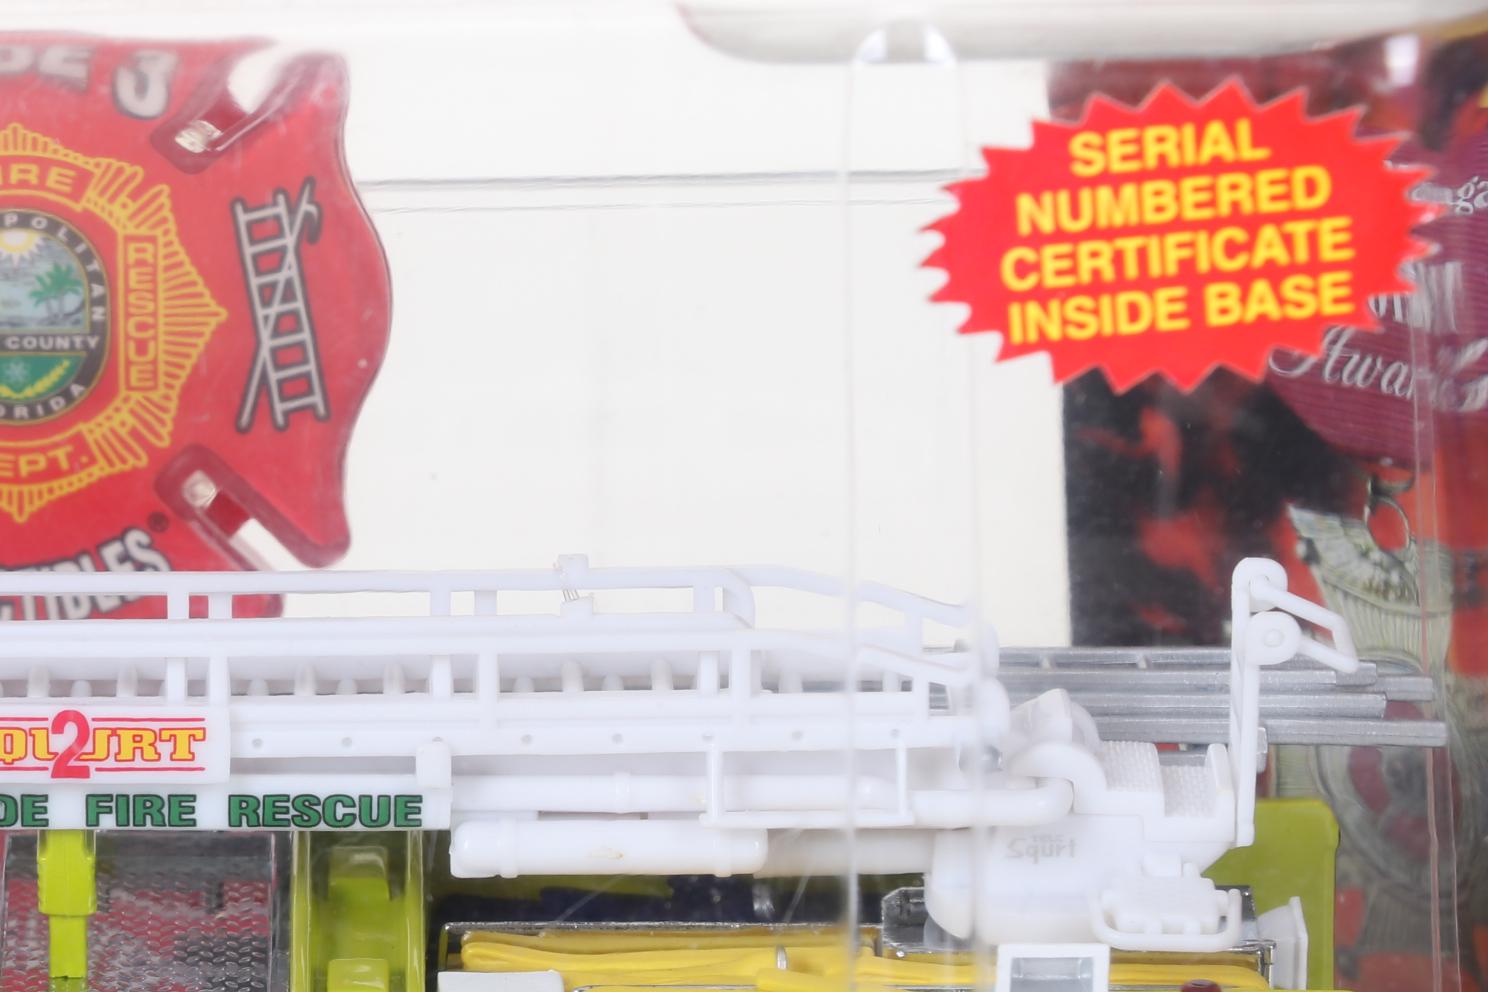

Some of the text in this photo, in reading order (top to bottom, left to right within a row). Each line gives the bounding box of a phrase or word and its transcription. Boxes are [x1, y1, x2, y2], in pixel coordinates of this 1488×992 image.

[1069, 118, 1271, 178] SERIAL
[1015, 165, 1332, 236] NUMBERED
[1000, 216, 1356, 291] CERTIFICATE
[6, 335, 100, 350] COUNTY
[125, 241, 156, 391] RESCUE
[1008, 286, 1190, 346] INSIDE
[1204, 271, 1354, 327] BASE
[50, 709, 91, 779] 2
[85, 793, 197, 828] FIRE
[228, 793, 423, 828] RESCUE
